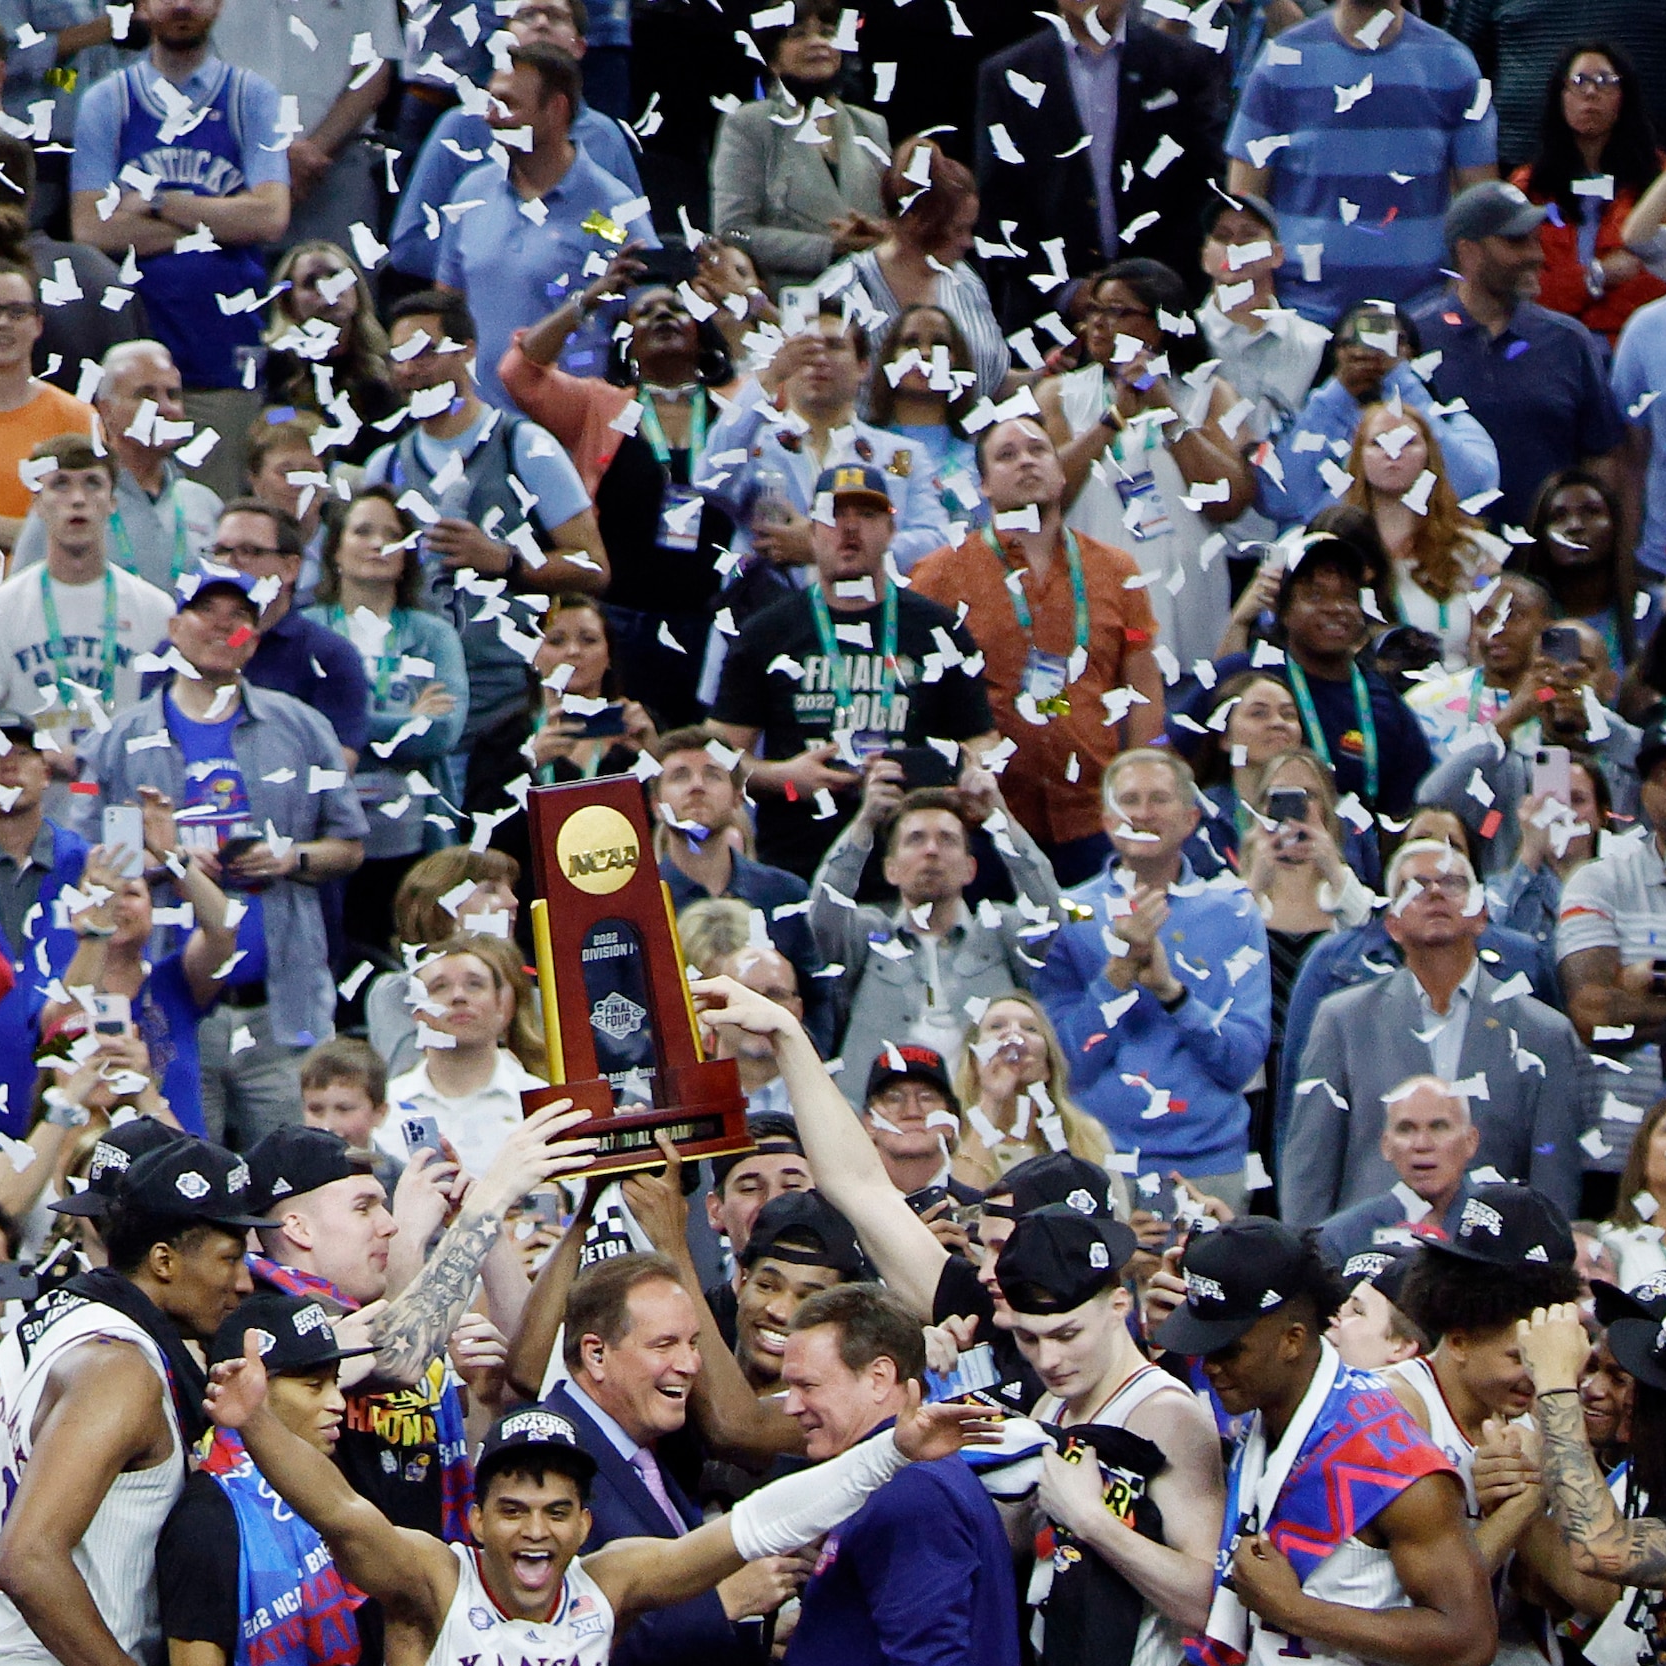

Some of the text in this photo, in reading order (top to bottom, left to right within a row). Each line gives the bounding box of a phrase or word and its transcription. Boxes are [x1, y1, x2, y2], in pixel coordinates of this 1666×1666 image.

[121, 147, 245, 196] NTUCKY
[568, 846, 639, 878] NCAA
[593, 932, 619, 947] 2022
[581, 943, 627, 963] DIVISION
[604, 1001, 631, 1016] FINAL
[604, 1013, 631, 1031] FOUR
